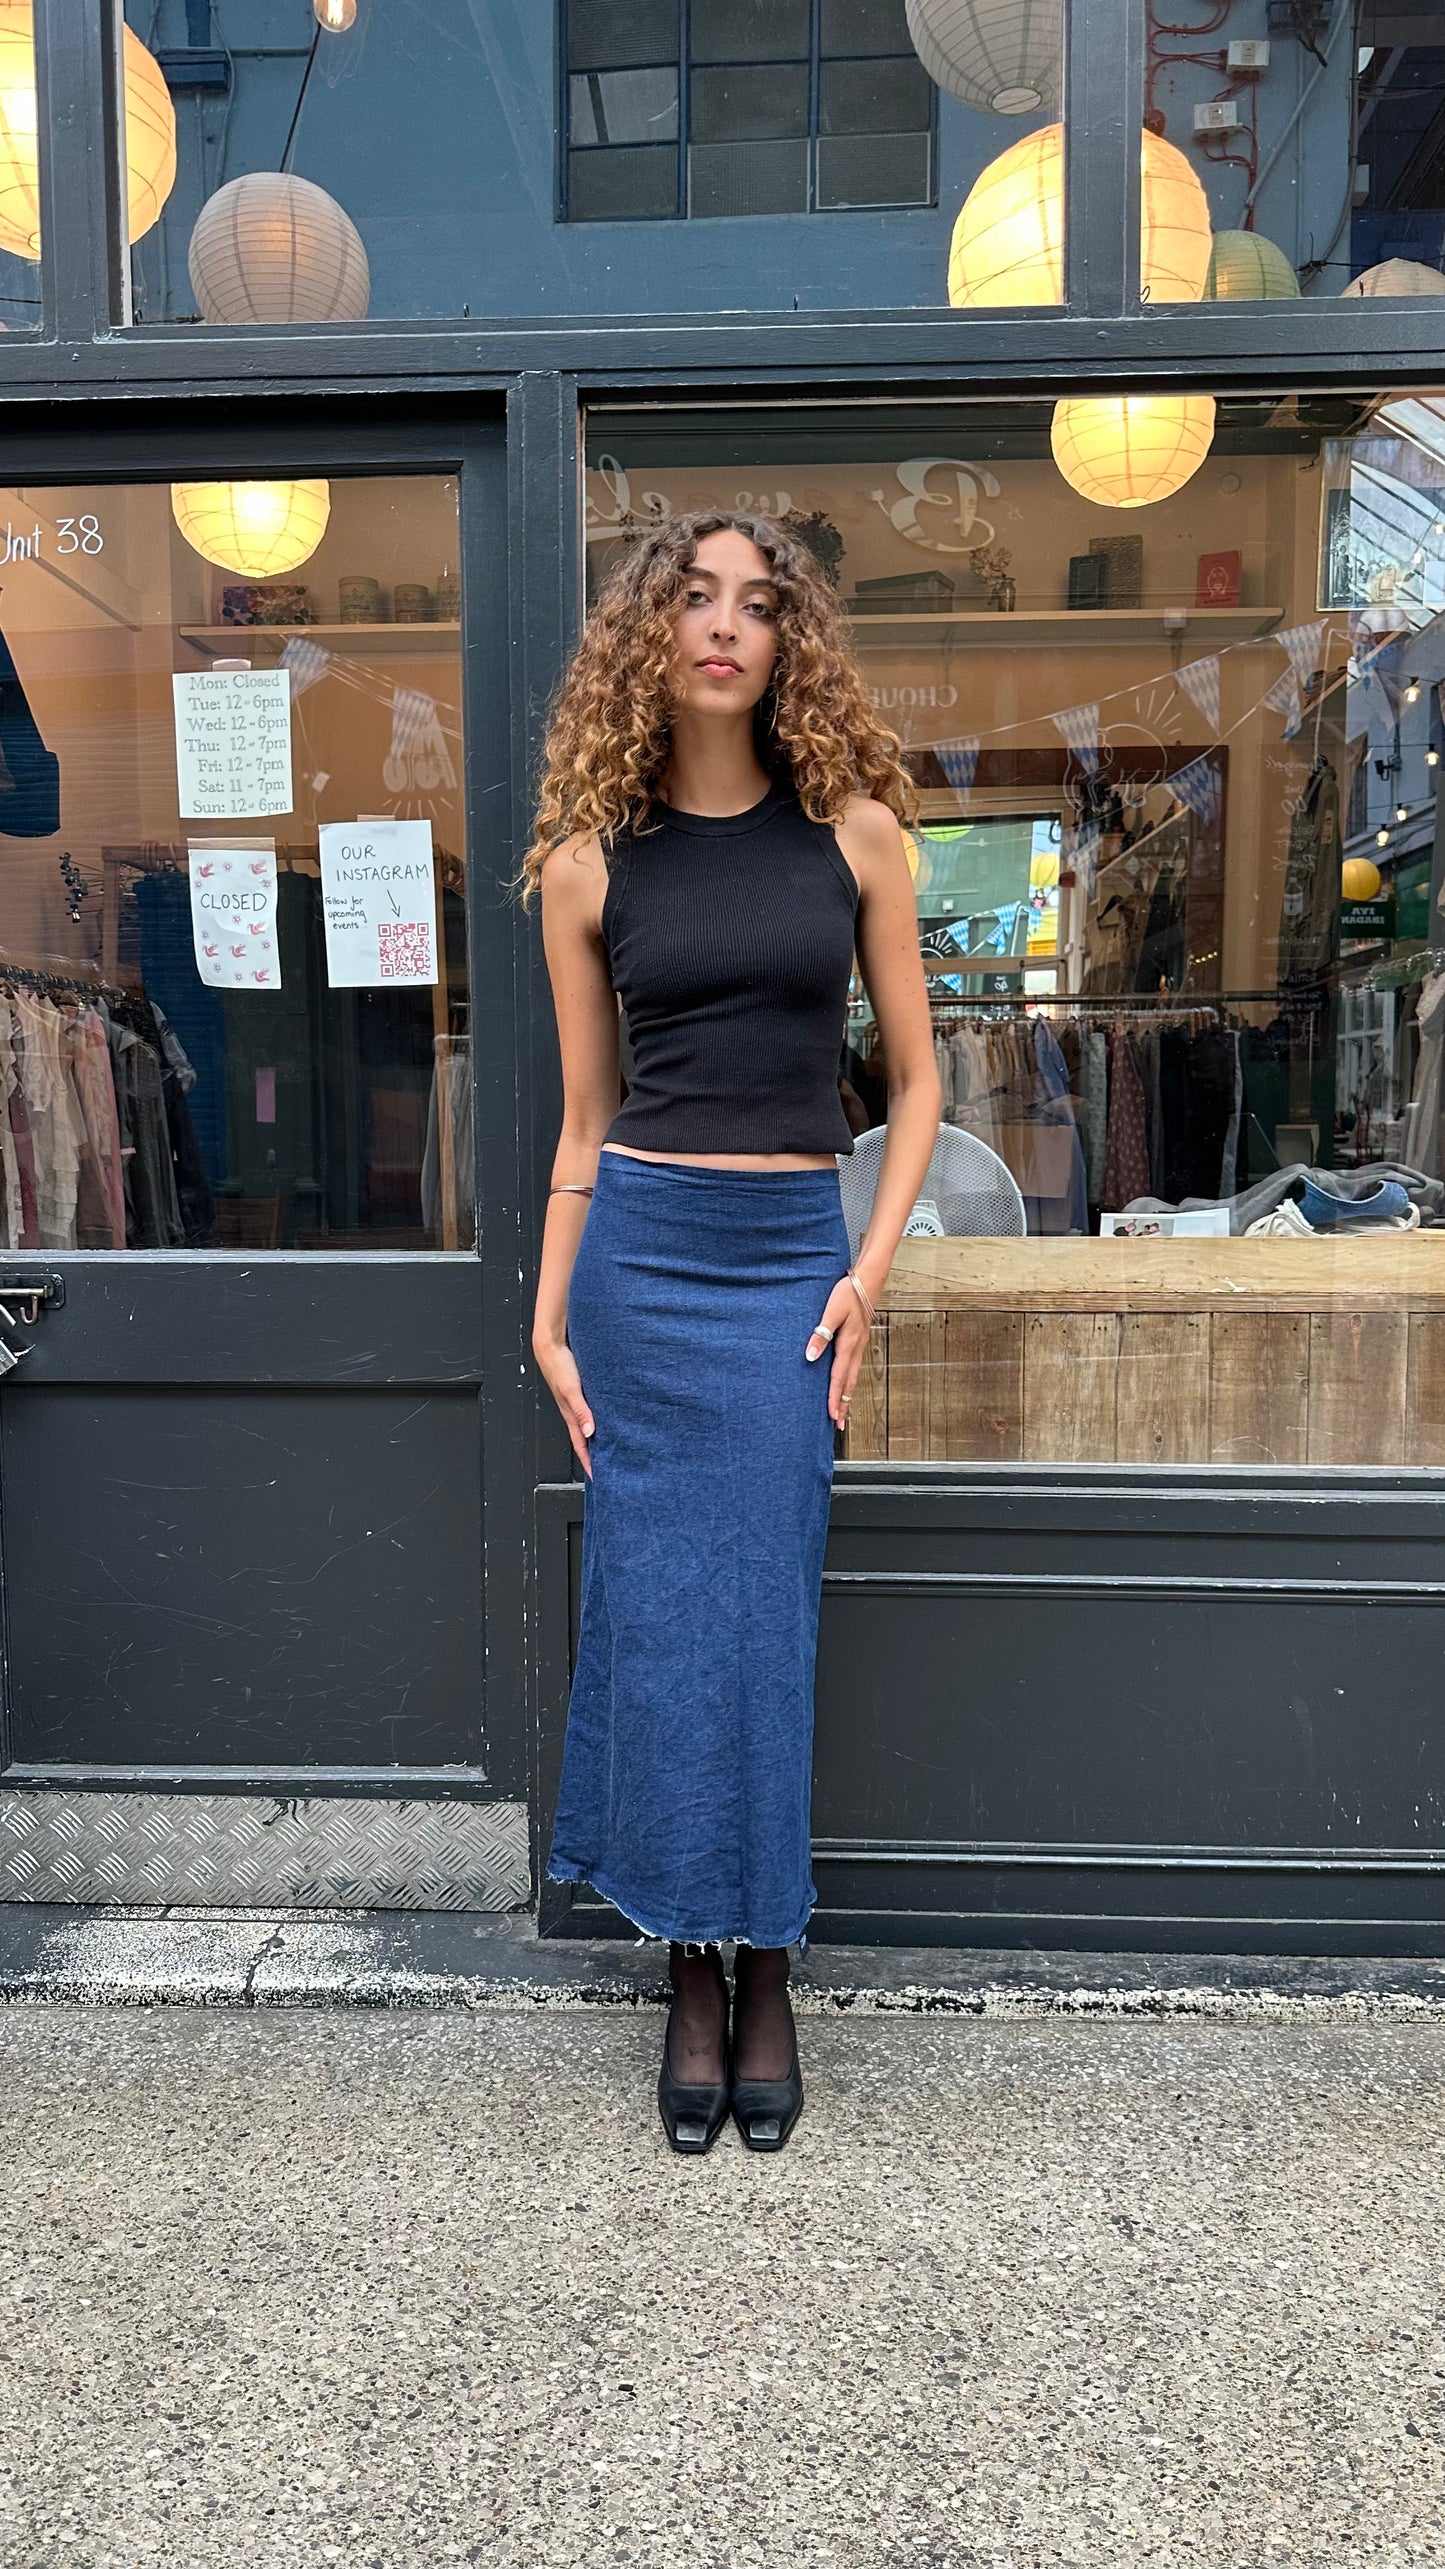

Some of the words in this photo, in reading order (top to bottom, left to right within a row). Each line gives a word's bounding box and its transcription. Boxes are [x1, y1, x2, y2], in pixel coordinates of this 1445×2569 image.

[56, 514, 104, 555] 38
[189, 676, 228, 690] Mon:
[232, 673, 280, 688] Closed
[188, 697, 221, 710] Tue:
[187, 718, 226, 731] Wed:
[184, 738, 220, 752] Thu:
[197, 759, 222, 772] Fri:
[198, 780, 224, 793] Sat:
[193, 800, 225, 813] Sun:
[341, 844, 376, 860] OUR
[336, 863, 430, 882] INSTAGRAM
[200, 892, 268, 912] CLOSED
[324, 896, 348, 906] Follow
[350, 895, 364, 911] for
[327, 909, 368, 924] upcoming
[332, 921, 360, 930] events
